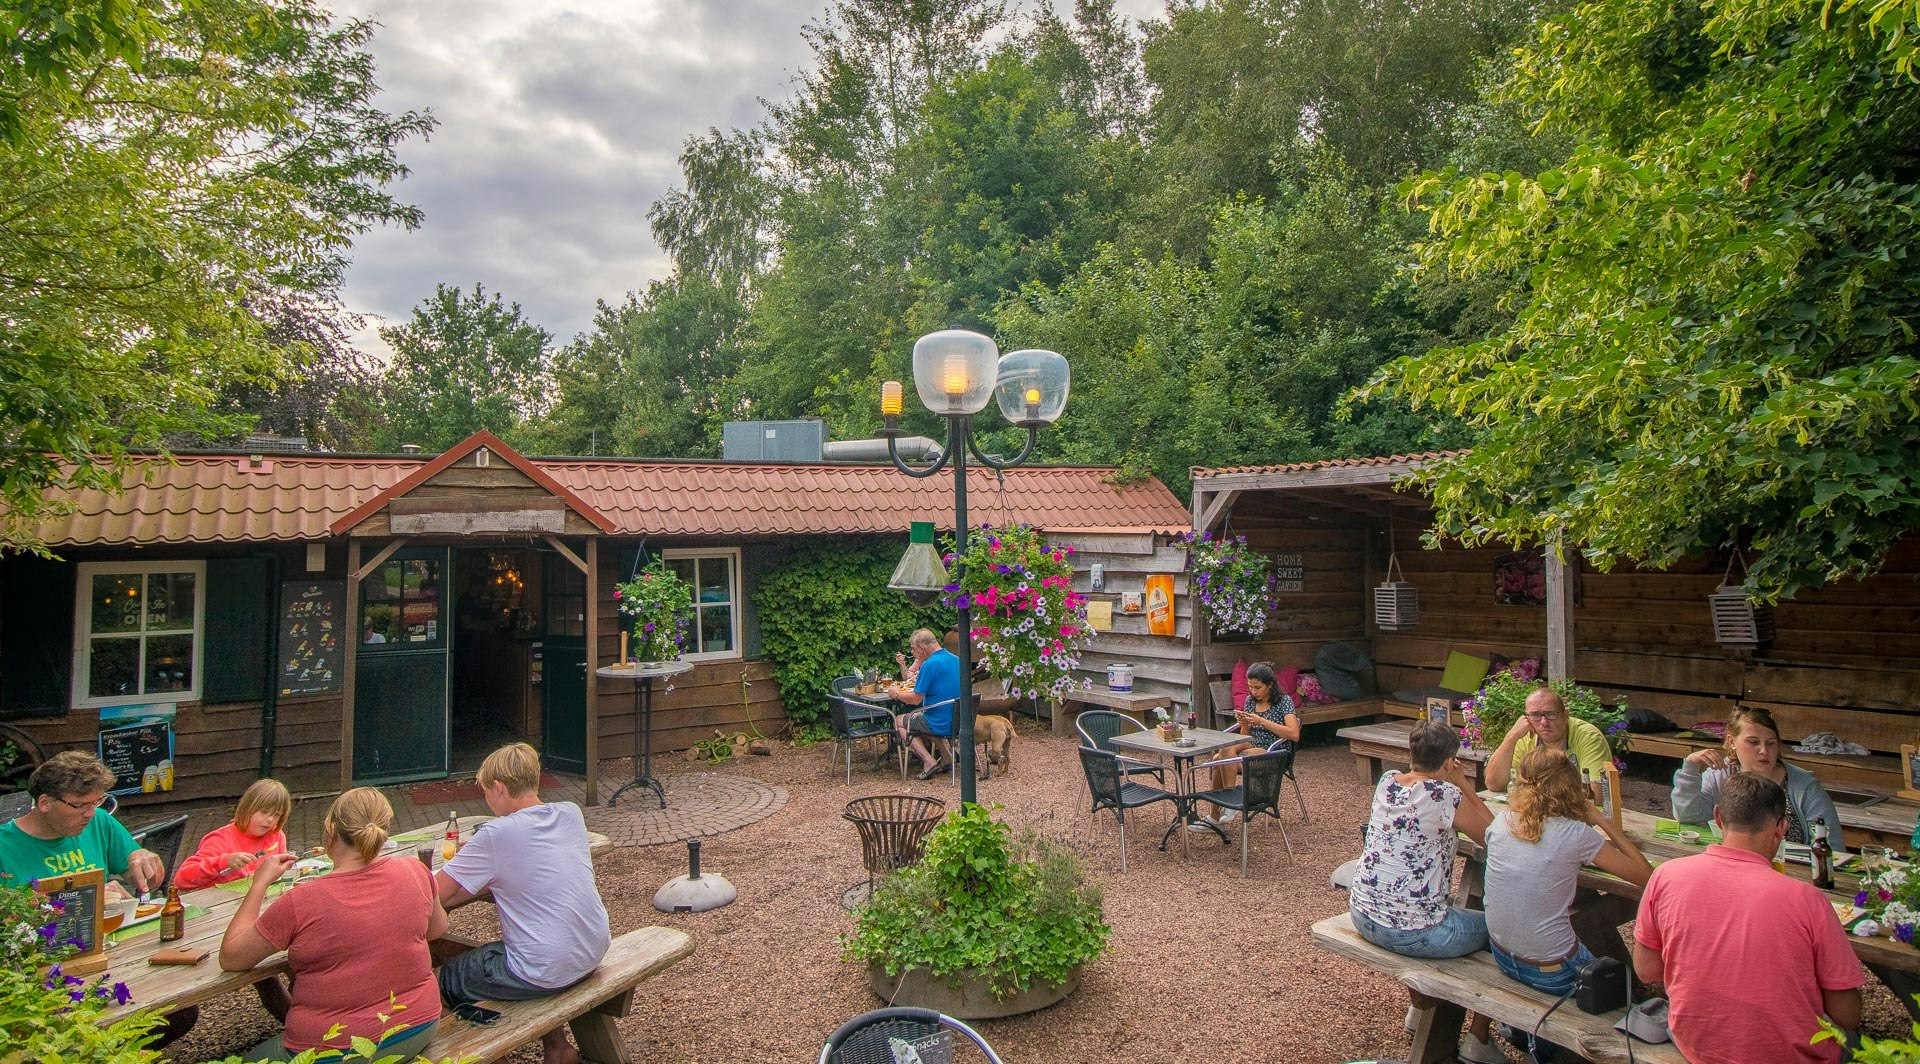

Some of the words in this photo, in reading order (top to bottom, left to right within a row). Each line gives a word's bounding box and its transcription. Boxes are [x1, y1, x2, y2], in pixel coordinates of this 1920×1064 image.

[1277, 554, 1303, 566] HOME
[1277, 567, 1304, 579] SWEET
[1277, 580, 1304, 592] GARDEN
[44, 848, 85, 873] SUN
[58, 891, 79, 900] Diner
[912, 1036, 940, 1051] Snacks
